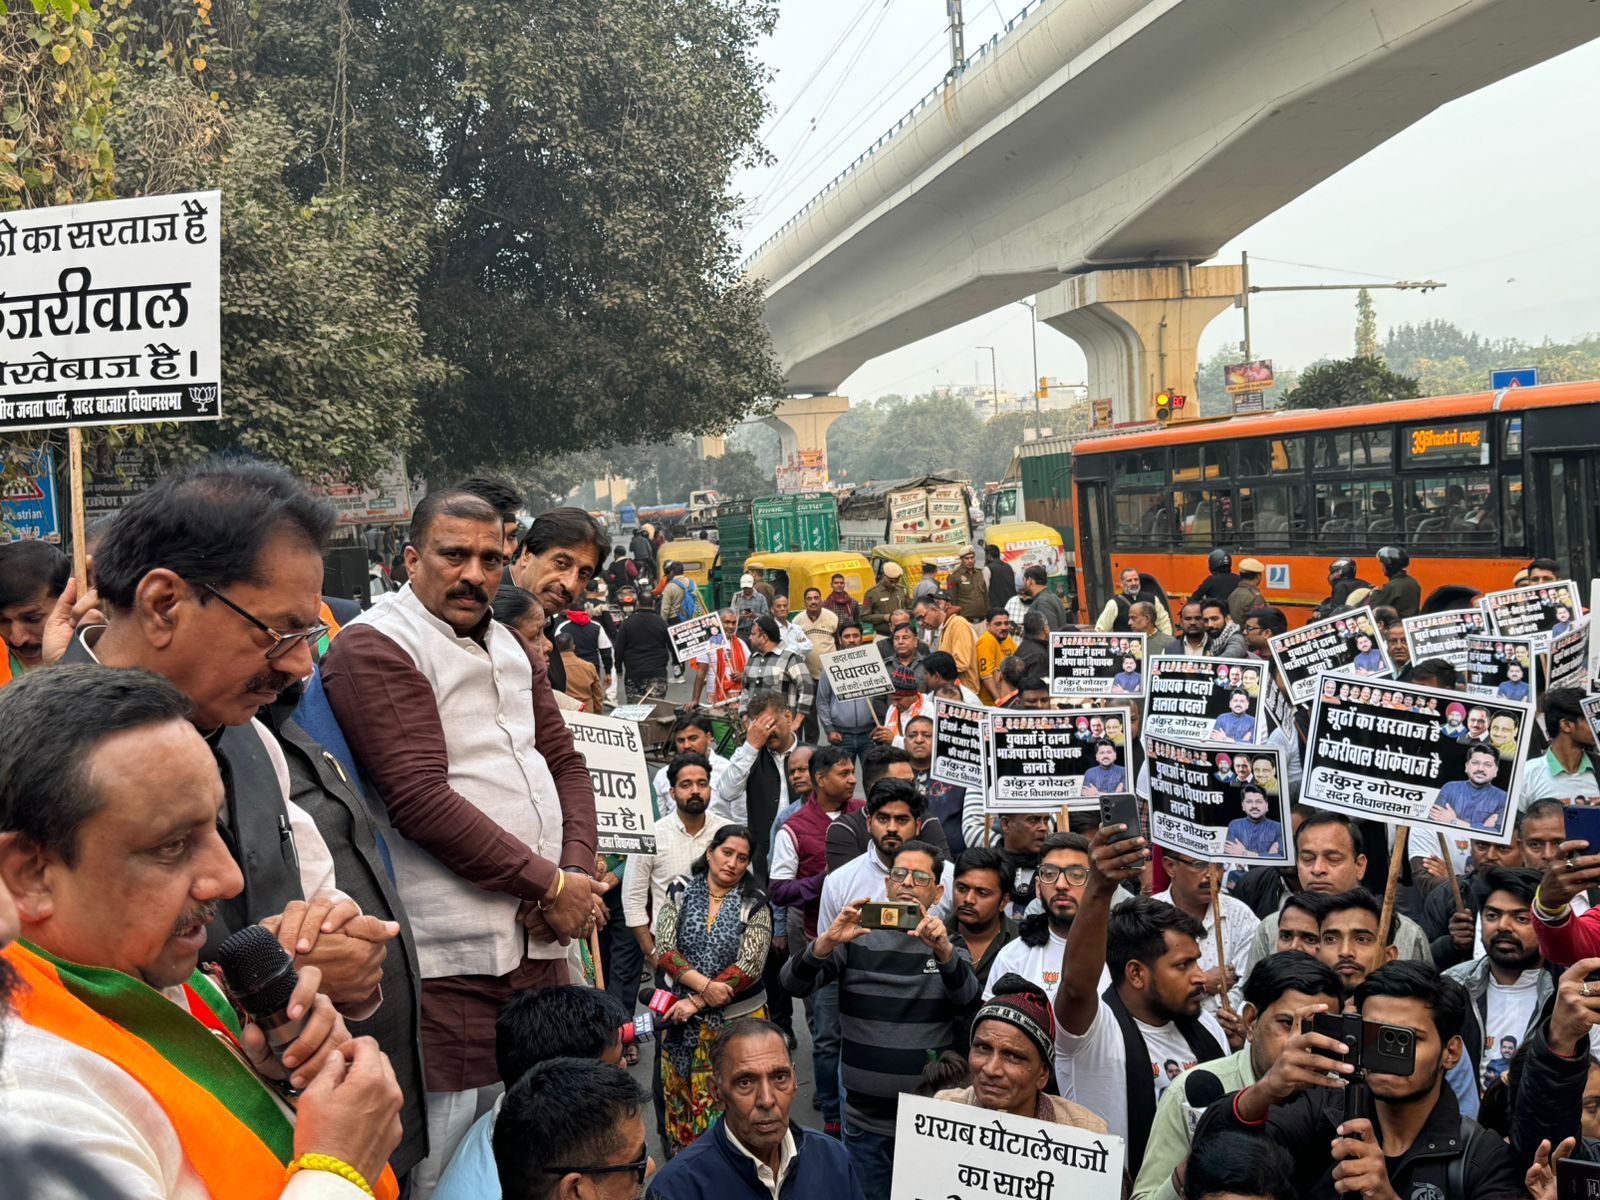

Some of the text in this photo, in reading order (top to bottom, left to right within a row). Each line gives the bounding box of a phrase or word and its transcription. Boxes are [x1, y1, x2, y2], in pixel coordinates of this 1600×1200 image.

[22, 225, 63, 253] का
[67, 213, 179, 249] सरताज
[181, 199, 208, 244] है
[0, 351, 142, 386] खेबाज
[16, 401, 44, 418] जनता
[72, 397, 94, 415] सदर
[129, 390, 182, 412] विधानसभा
[829, 662, 880, 682] विधायक
[1151, 675, 1214, 696] विधायक बदलो
[1296, 679, 1316, 690] अंकु
[1178, 696, 1207, 715] बदलो
[1150, 717, 1208, 729] अंकुर गोयल
[1327, 706, 1441, 742] झूठों का सरताज है
[569, 723, 638, 752] सरताज है
[1006, 730, 1037, 748] युवाओं
[1037, 731, 1046, 745] ने
[997, 746, 1082, 760] भाजपा का विधायक
[1318, 733, 1442, 778] केजरीवाल धोकेबाज है
[1022, 760, 1056, 774] लाना है
[1003, 777, 1075, 789] अंकुर गोयल
[1030, 788, 1069, 797] विधानसभा
[1151, 776, 1224, 805] भाजपा का विधायक
[1318, 767, 1426, 802] अंकुर गोयल
[1170, 800, 1189, 818] लाना
[1325, 788, 1411, 815] सदर विधानसभा
[1157, 815, 1218, 841] अंकुर गोयल
[1162, 831, 1209, 853] सदर विधानसभा
[914, 1113, 1109, 1173] शराब घोटालेबाजो
[958, 1163, 1055, 1200] का साथी
